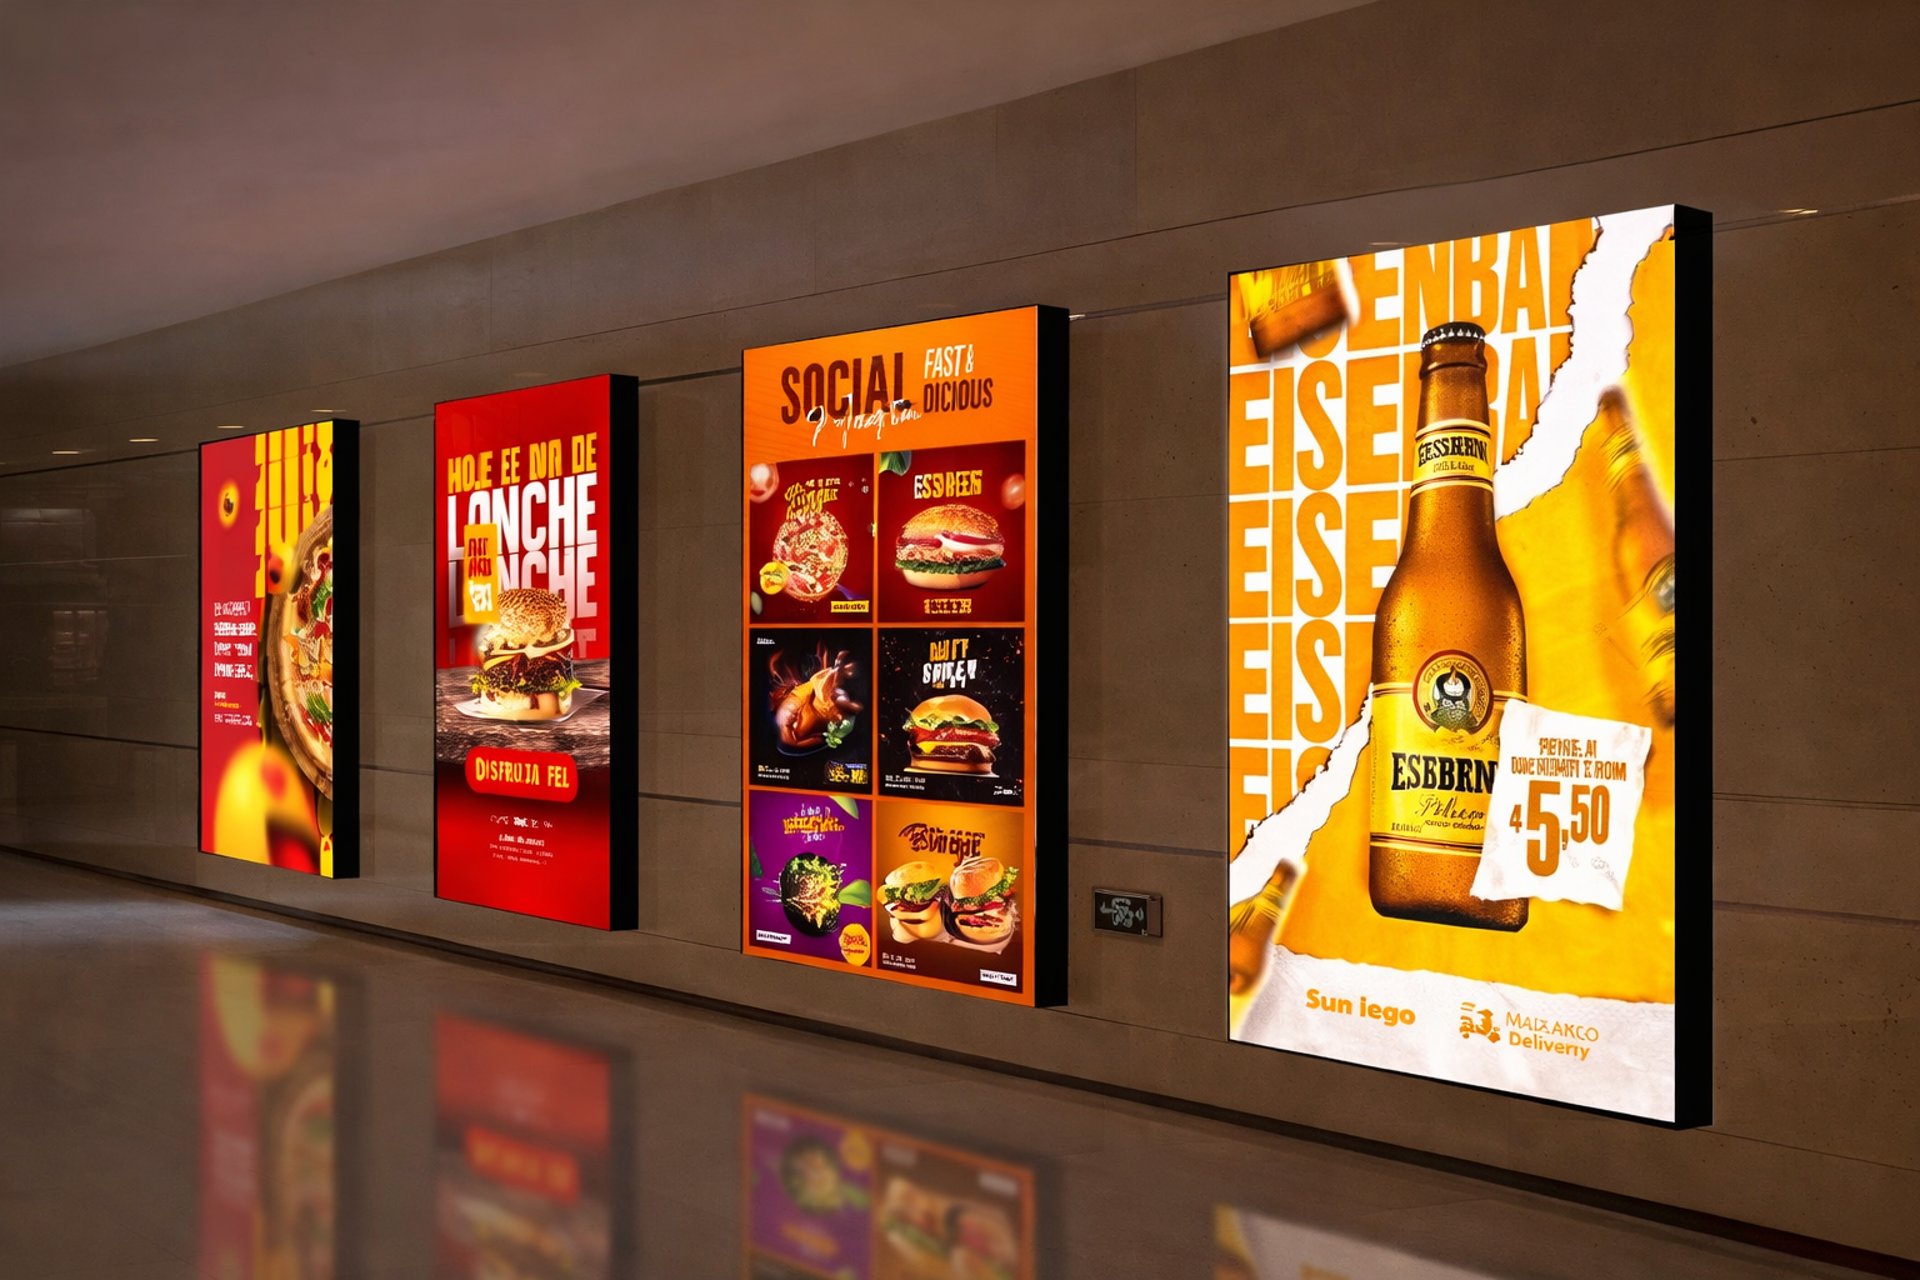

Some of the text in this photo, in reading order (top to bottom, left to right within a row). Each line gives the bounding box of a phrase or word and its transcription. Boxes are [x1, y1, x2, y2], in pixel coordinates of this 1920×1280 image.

[781, 352, 906, 425] SOCIAL
[571, 432, 597, 474] DE
[1305, 988, 1416, 1027] Sun iego
